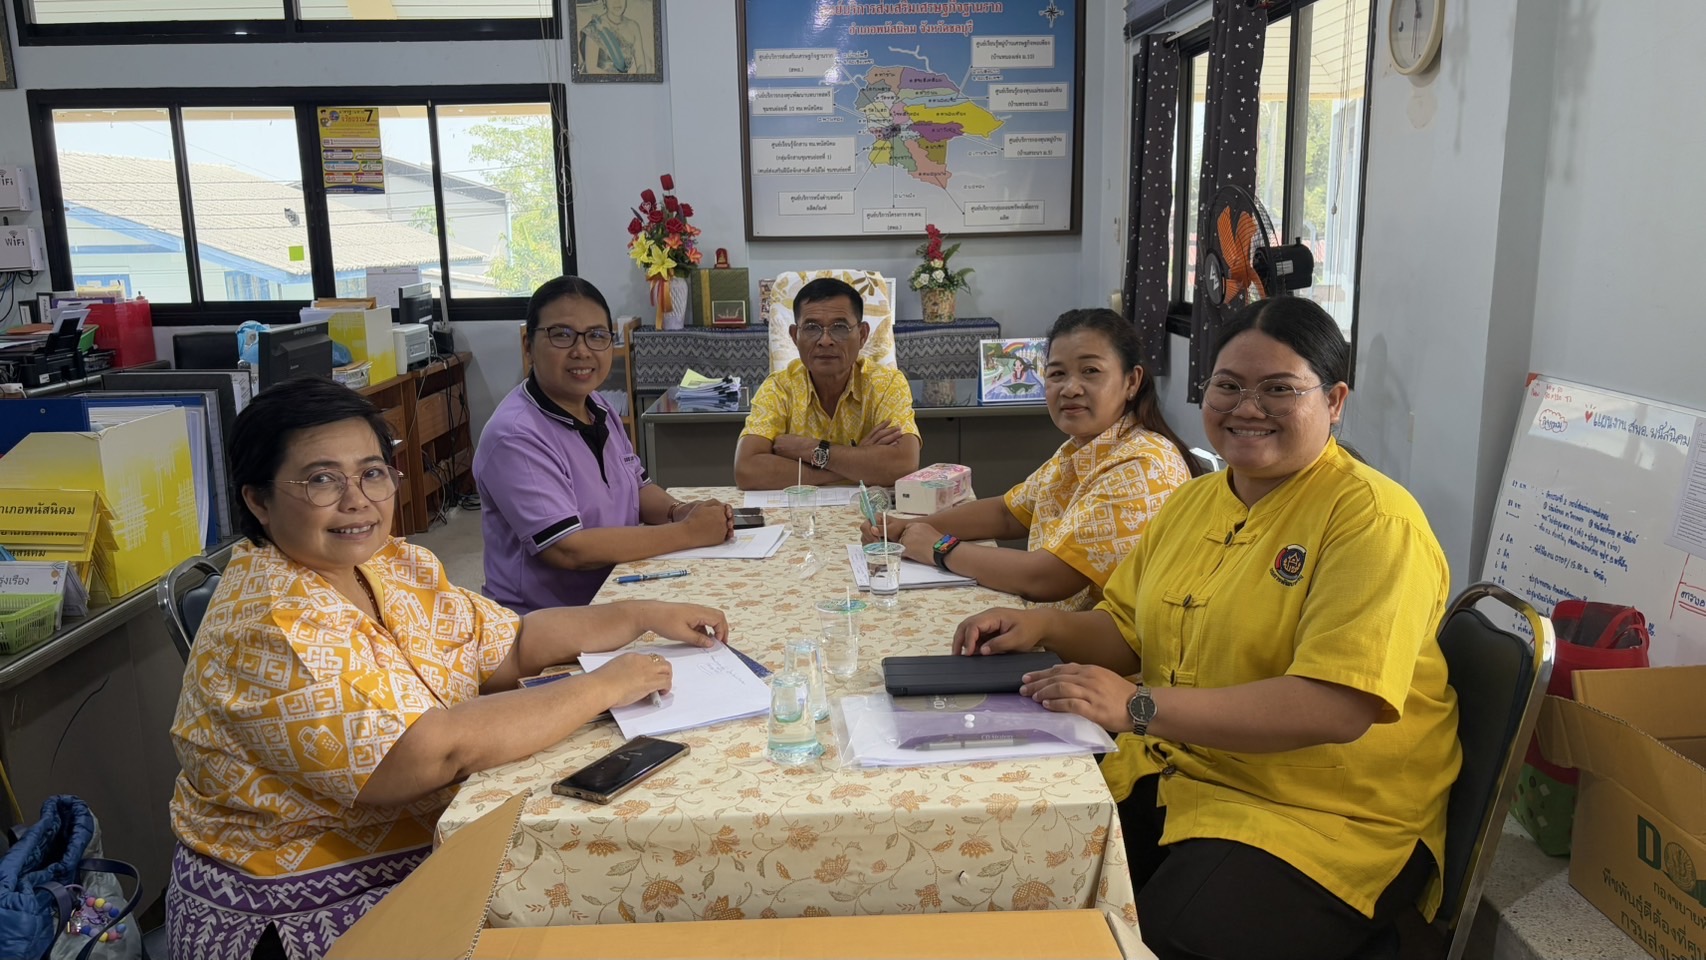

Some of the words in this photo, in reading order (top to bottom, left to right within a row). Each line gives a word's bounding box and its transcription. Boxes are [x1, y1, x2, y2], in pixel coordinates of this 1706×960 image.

[849, 20, 916, 35] อำเภอพนัสนิคม
[920, 20, 974, 36] จังหวัดชลบุรี
[364, 110, 373, 122] 7
[0, 175, 13, 186] iFi
[5, 235, 25, 246] WiFi
[1594, 412, 1626, 431] แผนงาน
[1650, 421, 1690, 448] พนัสนิคม
[1638, 814, 1662, 870] D
[1602, 867, 1706, 960] พืชพันธุ์ดีต้องที่ศู
[1654, 882, 1706, 930] กองขยายพ
